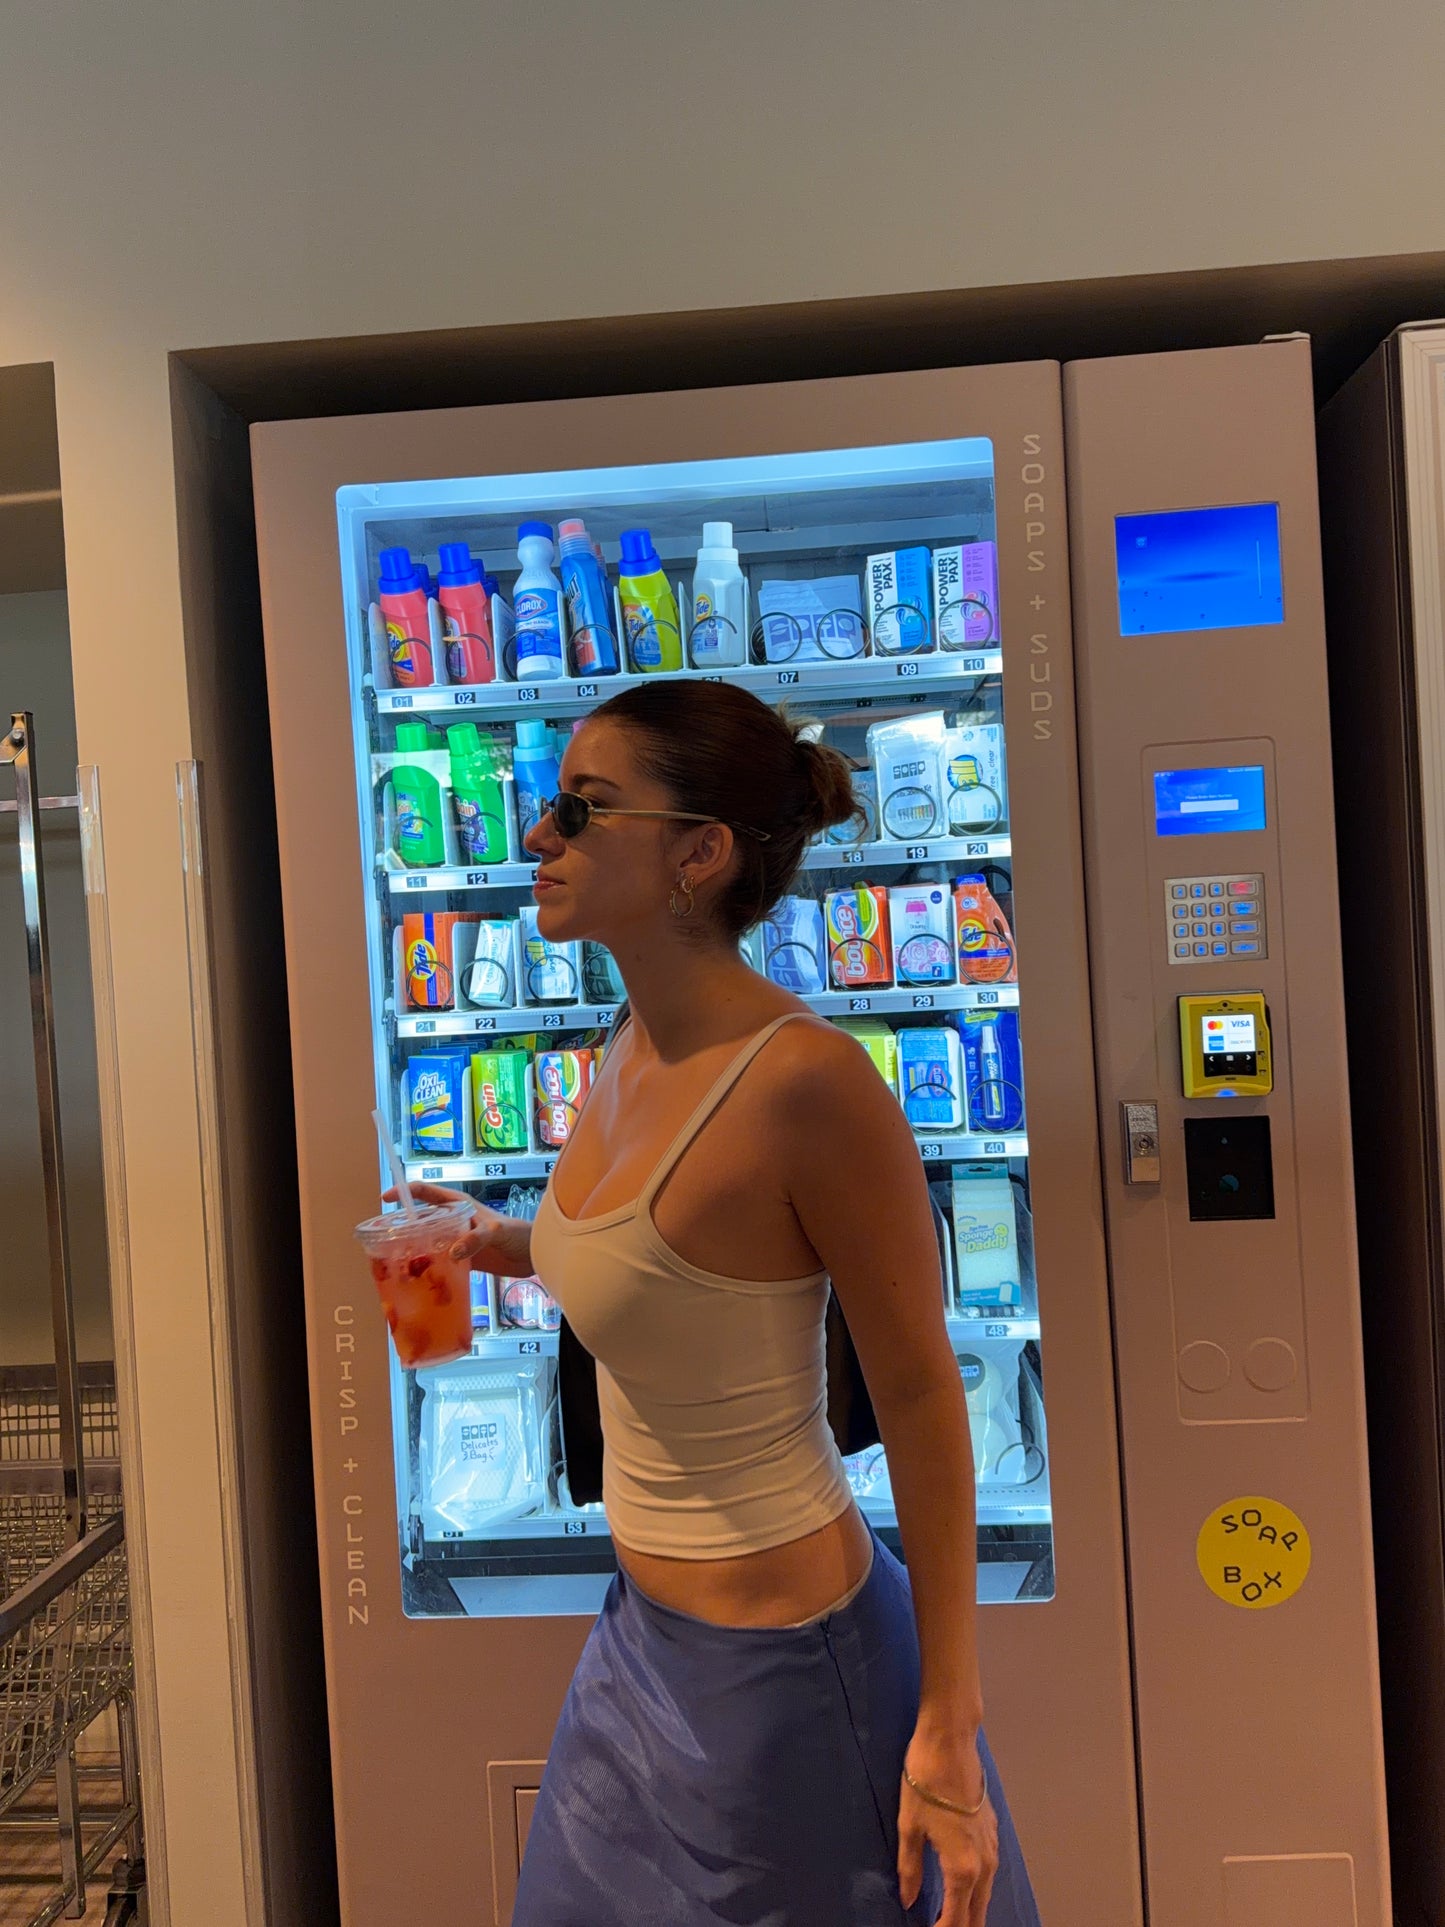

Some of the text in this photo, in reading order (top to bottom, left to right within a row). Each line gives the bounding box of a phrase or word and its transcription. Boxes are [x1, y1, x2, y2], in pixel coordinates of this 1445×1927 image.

[1021, 434, 1046, 572] SOAPS
[948, 556, 959, 584] PAX
[882, 562, 893, 590] PAX
[938, 557, 949, 606] POWER
[872, 564, 884, 613] POWER
[516, 599, 542, 616] CLOROX
[695, 601, 710, 614] Tide
[901, 664, 917, 675] 09
[967, 659, 983, 670] 10
[780, 672, 796, 683] 07
[579, 685, 595, 696] 04
[1030, 633, 1053, 740] SUDS
[457, 693, 473, 704] 02
[520, 689, 535, 700] 03
[395, 697, 410, 708] 01
[909, 847, 925, 858] 19
[970, 843, 986, 854] 20
[847, 852, 862, 863] 18
[408, 877, 423, 887] 11
[469, 874, 485, 884] 12
[836, 904, 868, 977] bounce
[414, 943, 432, 977] Tide
[915, 996, 931, 1007] 29
[980, 993, 996, 1003] 30
[852, 1000, 868, 1010] 28
[477, 1018, 493, 1029] 22
[545, 1015, 561, 1025] 23
[1231, 1020, 1251, 1028] VISA
[418, 1023, 431, 1033] 21
[419, 1073, 438, 1090] OXI
[414, 1083, 446, 1103] CLEAN
[482, 1082, 503, 1129] Gain
[544, 1066, 570, 1139] bounce
[924, 1144, 940, 1155] 39
[987, 1142, 1003, 1153] 40
[423, 1168, 438, 1178] 31
[487, 1165, 503, 1175] 32
[959, 1229, 994, 1245] Sponge
[966, 1235, 1008, 1253] Daddy
[988, 1325, 1005, 1336] 48
[522, 1342, 537, 1353] 42
[334, 1305, 359, 1436] CRISP
[461, 1422, 497, 1440] SOAP
[461, 1438, 499, 1452] Delicates
[469, 1450, 488, 1463] Bag
[567, 1522, 583, 1533] 53
[1221, 1509, 1299, 1552] SOAP
[343, 1495, 369, 1626] CLEAN
[1223, 1566, 1283, 1602] BOX
